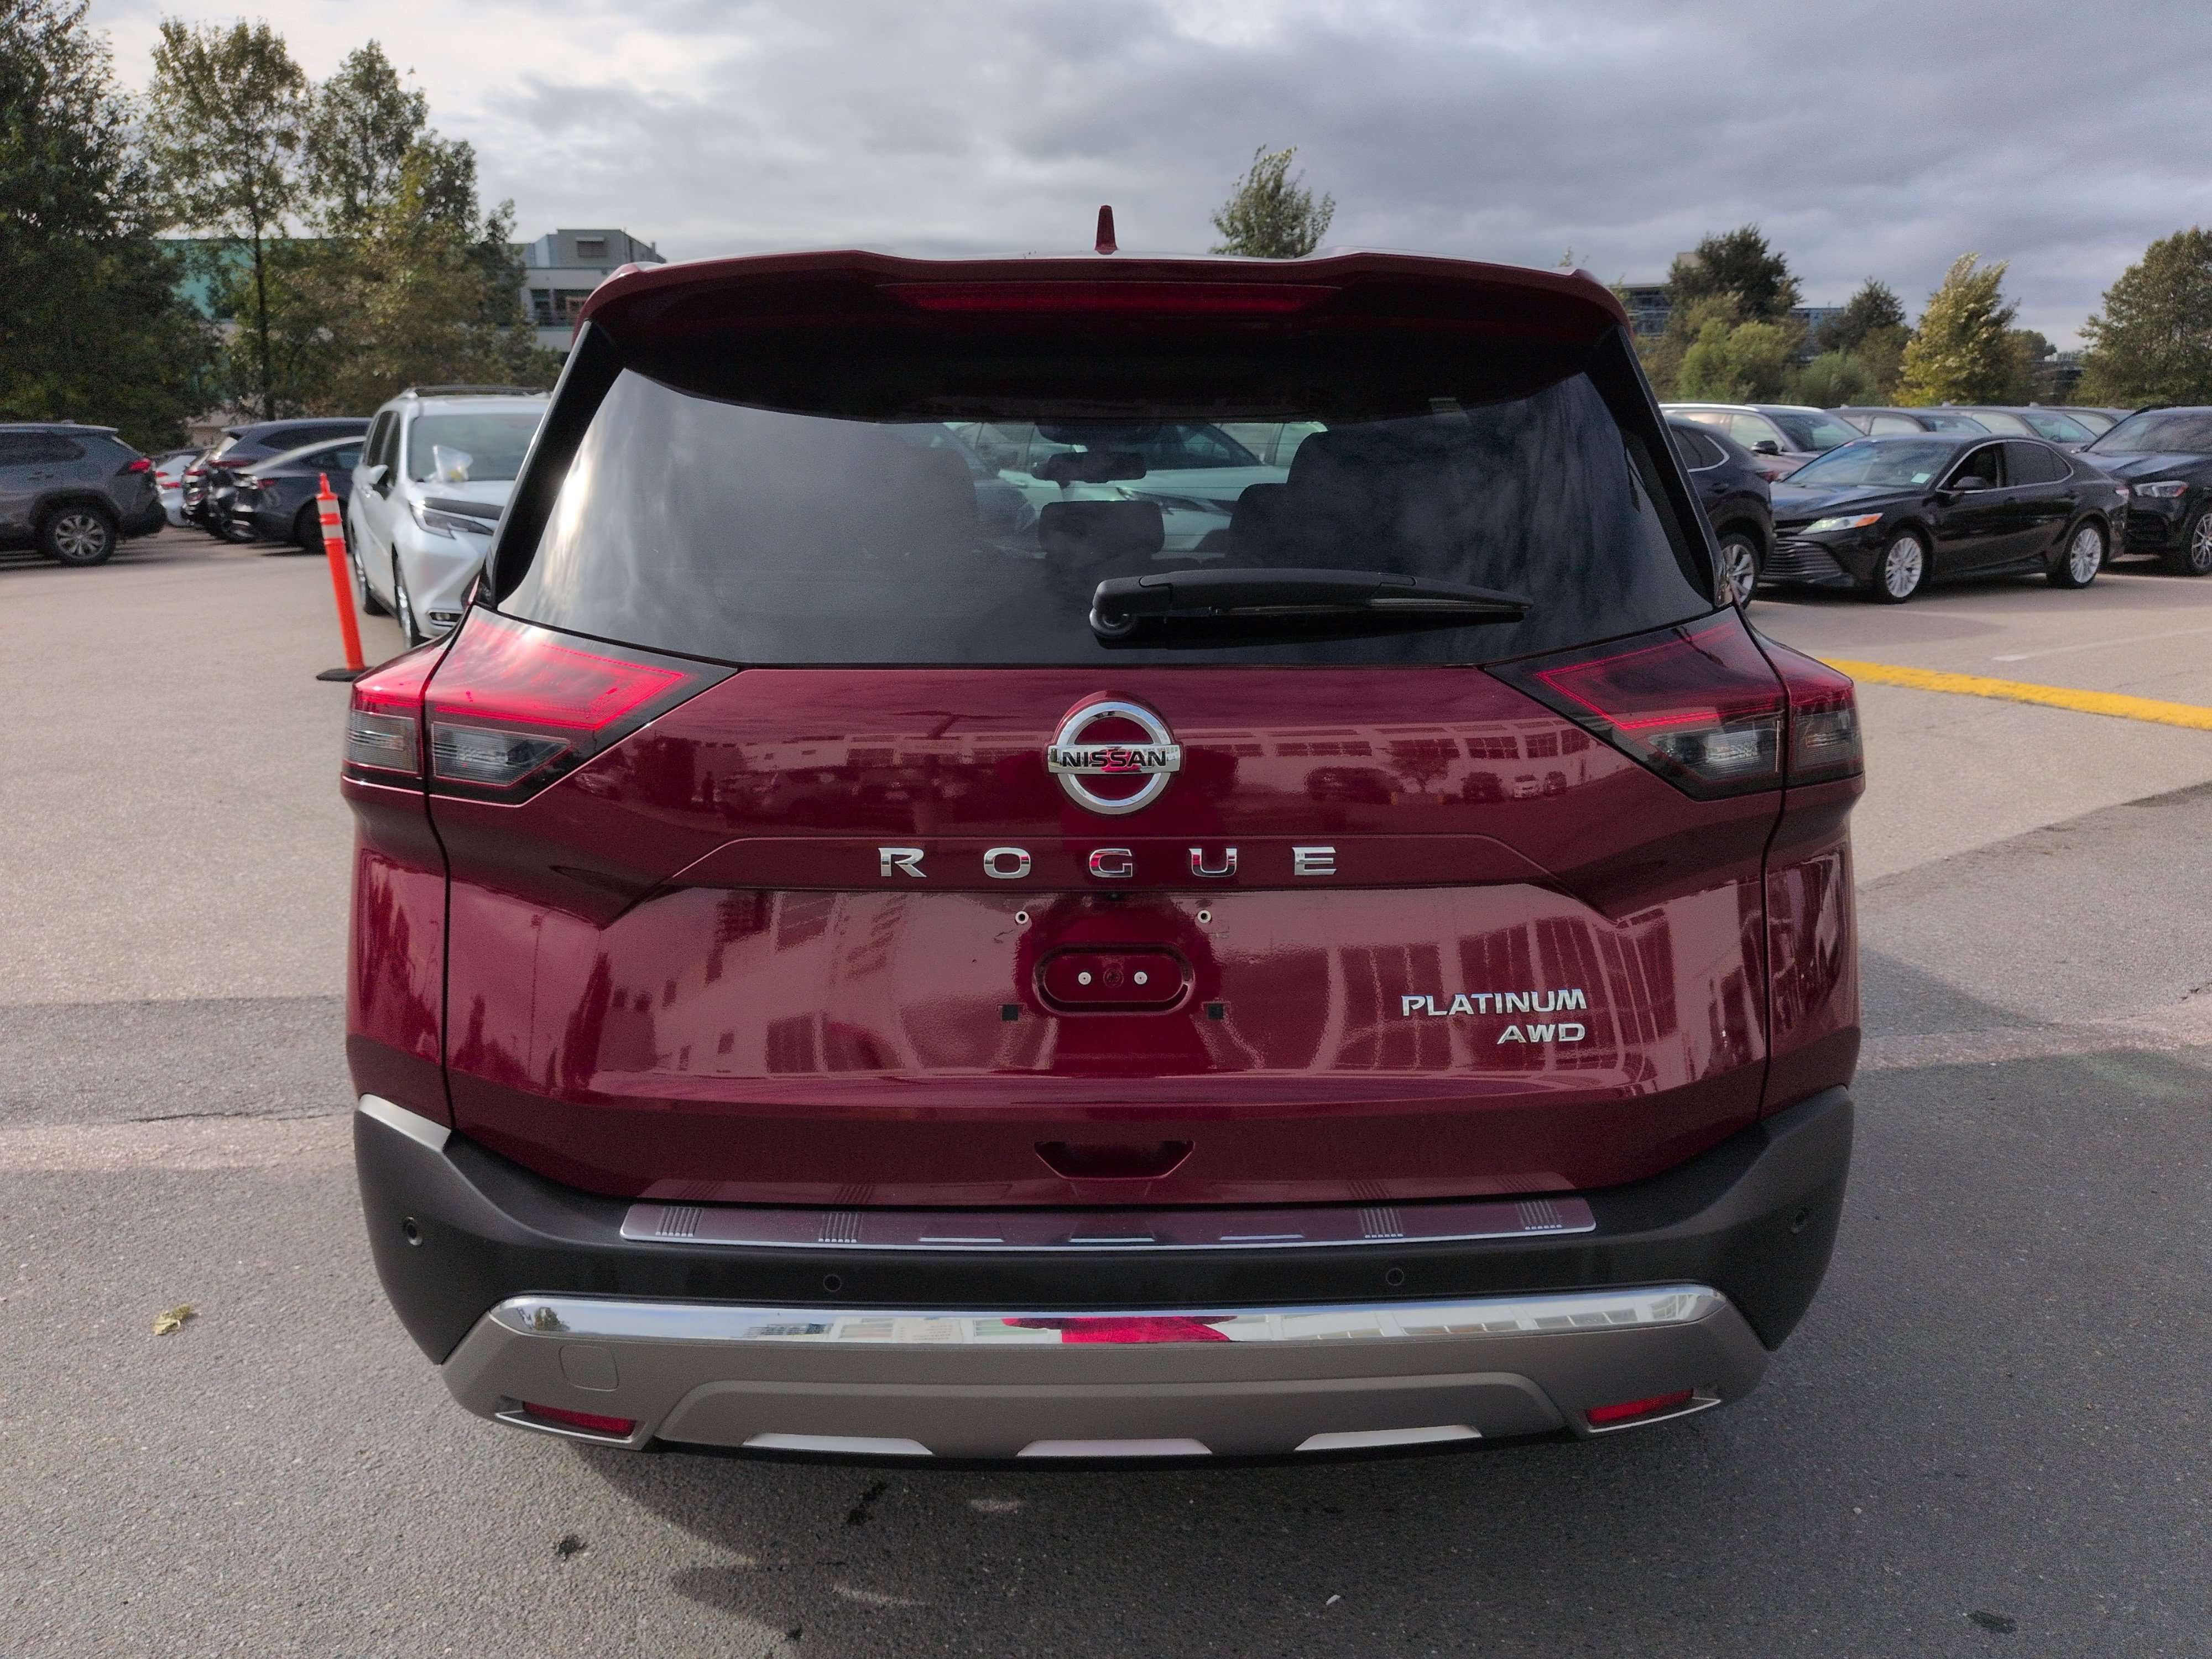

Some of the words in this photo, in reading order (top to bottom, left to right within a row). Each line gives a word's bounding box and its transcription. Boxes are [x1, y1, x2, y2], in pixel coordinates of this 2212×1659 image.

[1062, 750, 1166, 768] NISSAN
[878, 847, 1337, 879] ROGUE
[1401, 988, 1587, 1016] PLATINUM
[1497, 1023, 1585, 1044] AWD
